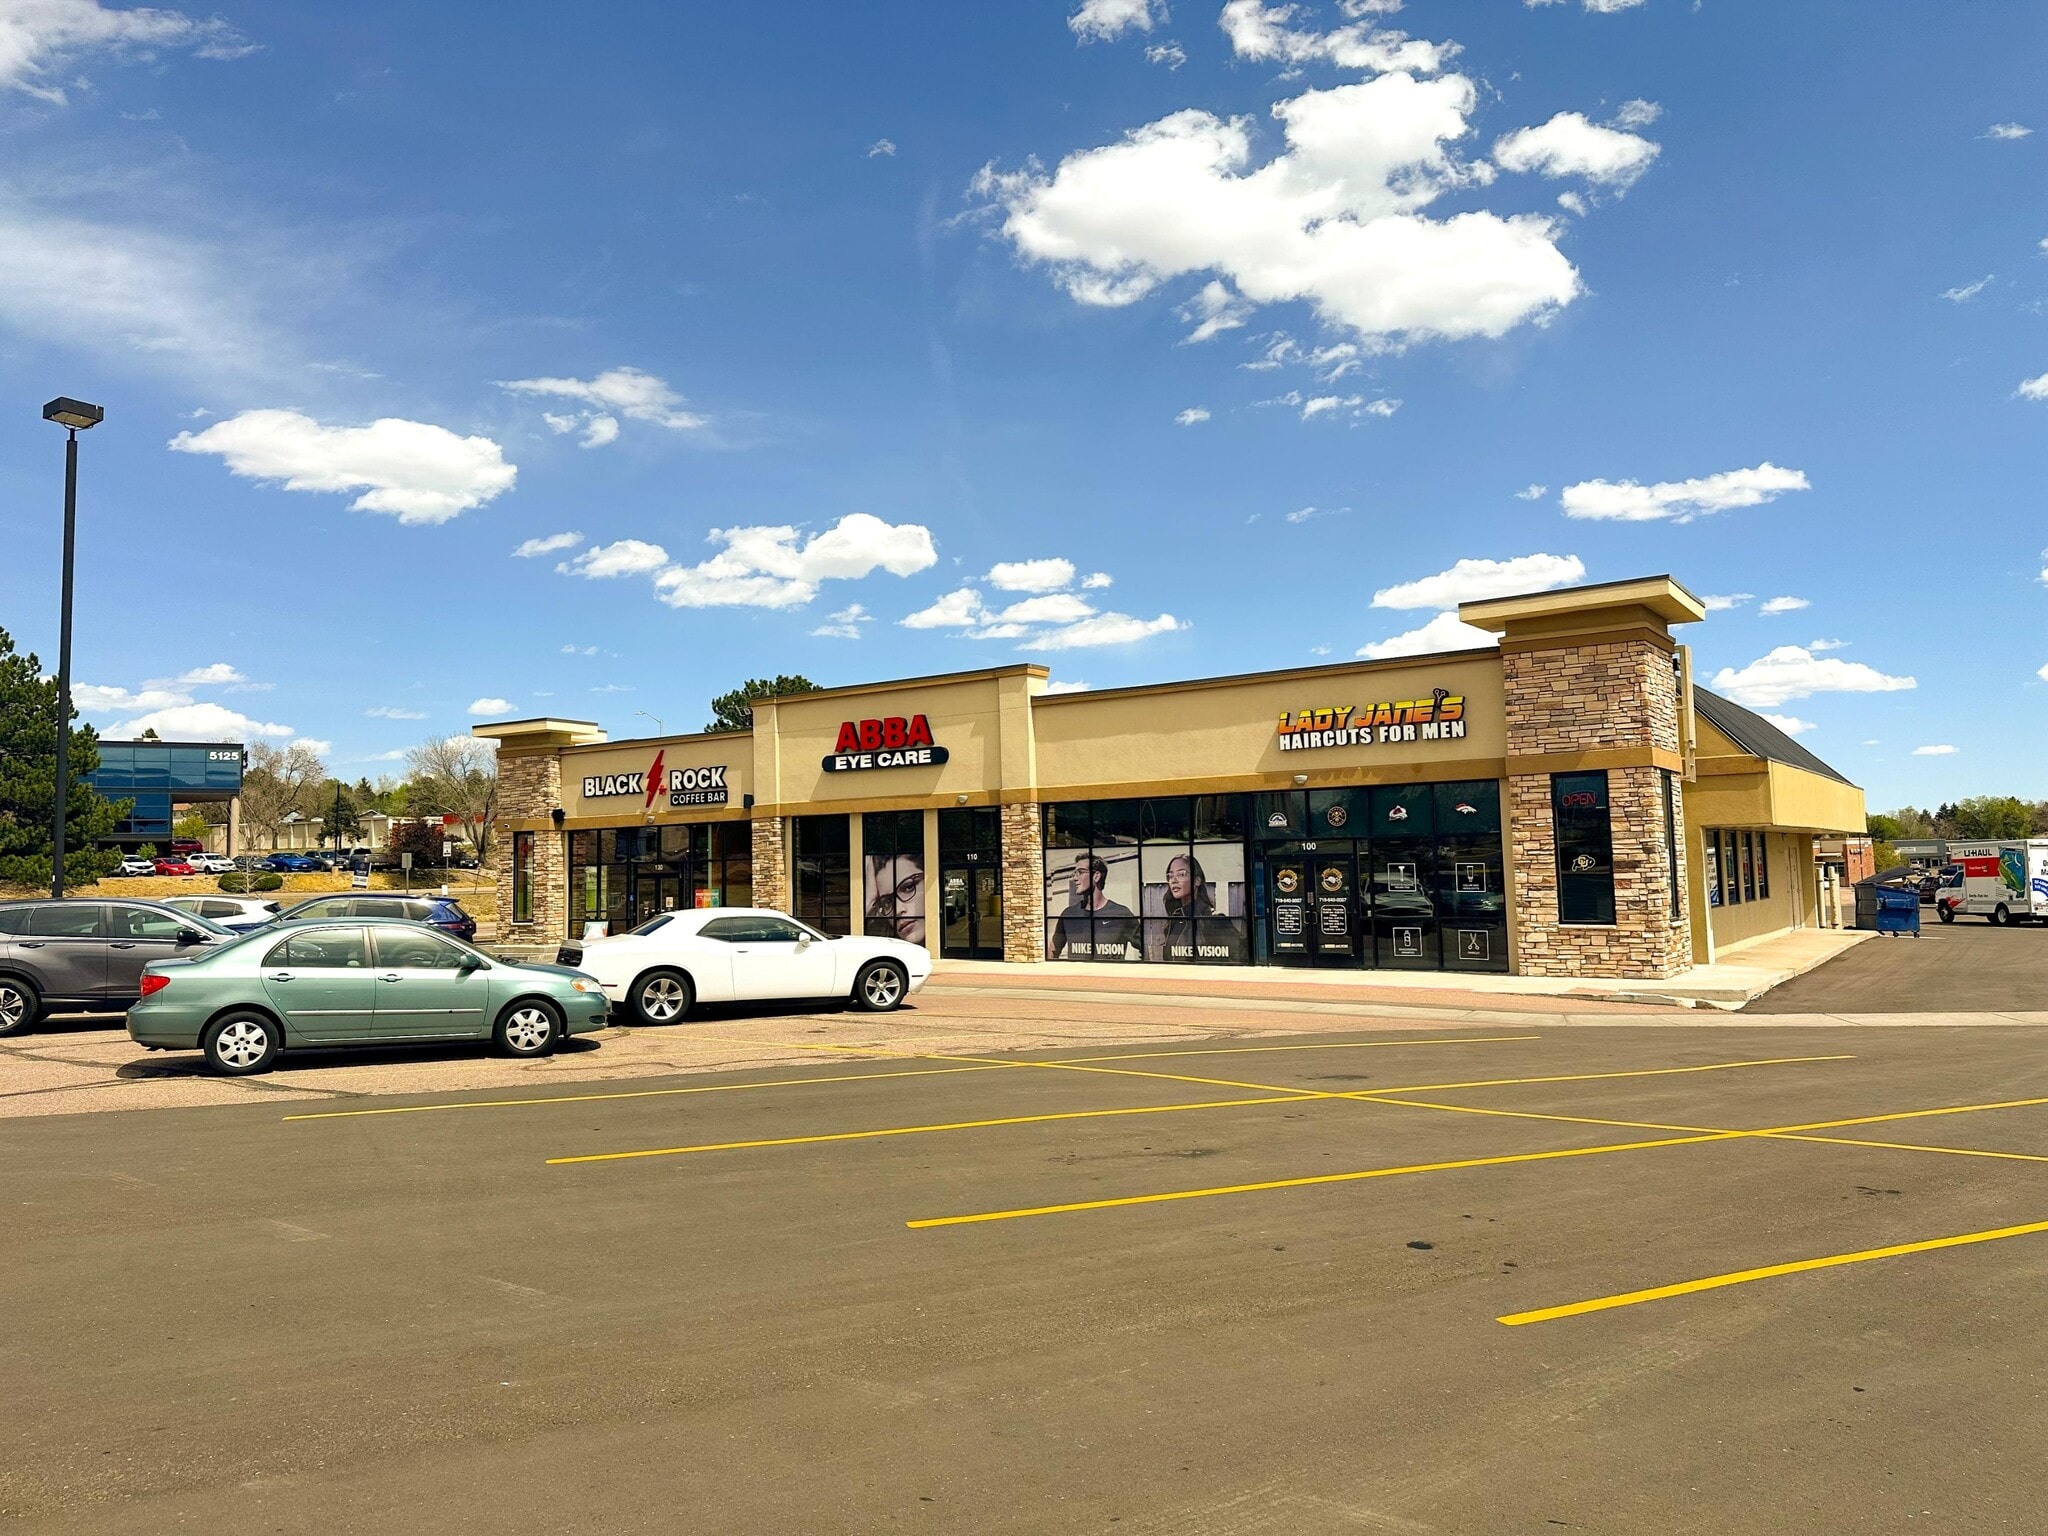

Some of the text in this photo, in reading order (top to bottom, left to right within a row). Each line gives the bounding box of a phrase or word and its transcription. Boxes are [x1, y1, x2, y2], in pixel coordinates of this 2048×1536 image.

[1278, 706, 1355, 734] LADY
[835, 714, 935, 753] ABBA
[1279, 720, 1466, 751] HAIRCUTS FOR MEN
[209, 751, 239, 761] 5125
[835, 749, 932, 770] EYE CARE
[584, 766, 727, 798] BLACK ROCK
[671, 791, 726, 805] COFFEE BAR
[1562, 793, 1596, 807] OPEN
[1301, 842, 1317, 851] 100
[1071, 943, 1125, 955] NIKE VISION
[1171, 945, 1229, 957] NIKE VISION
